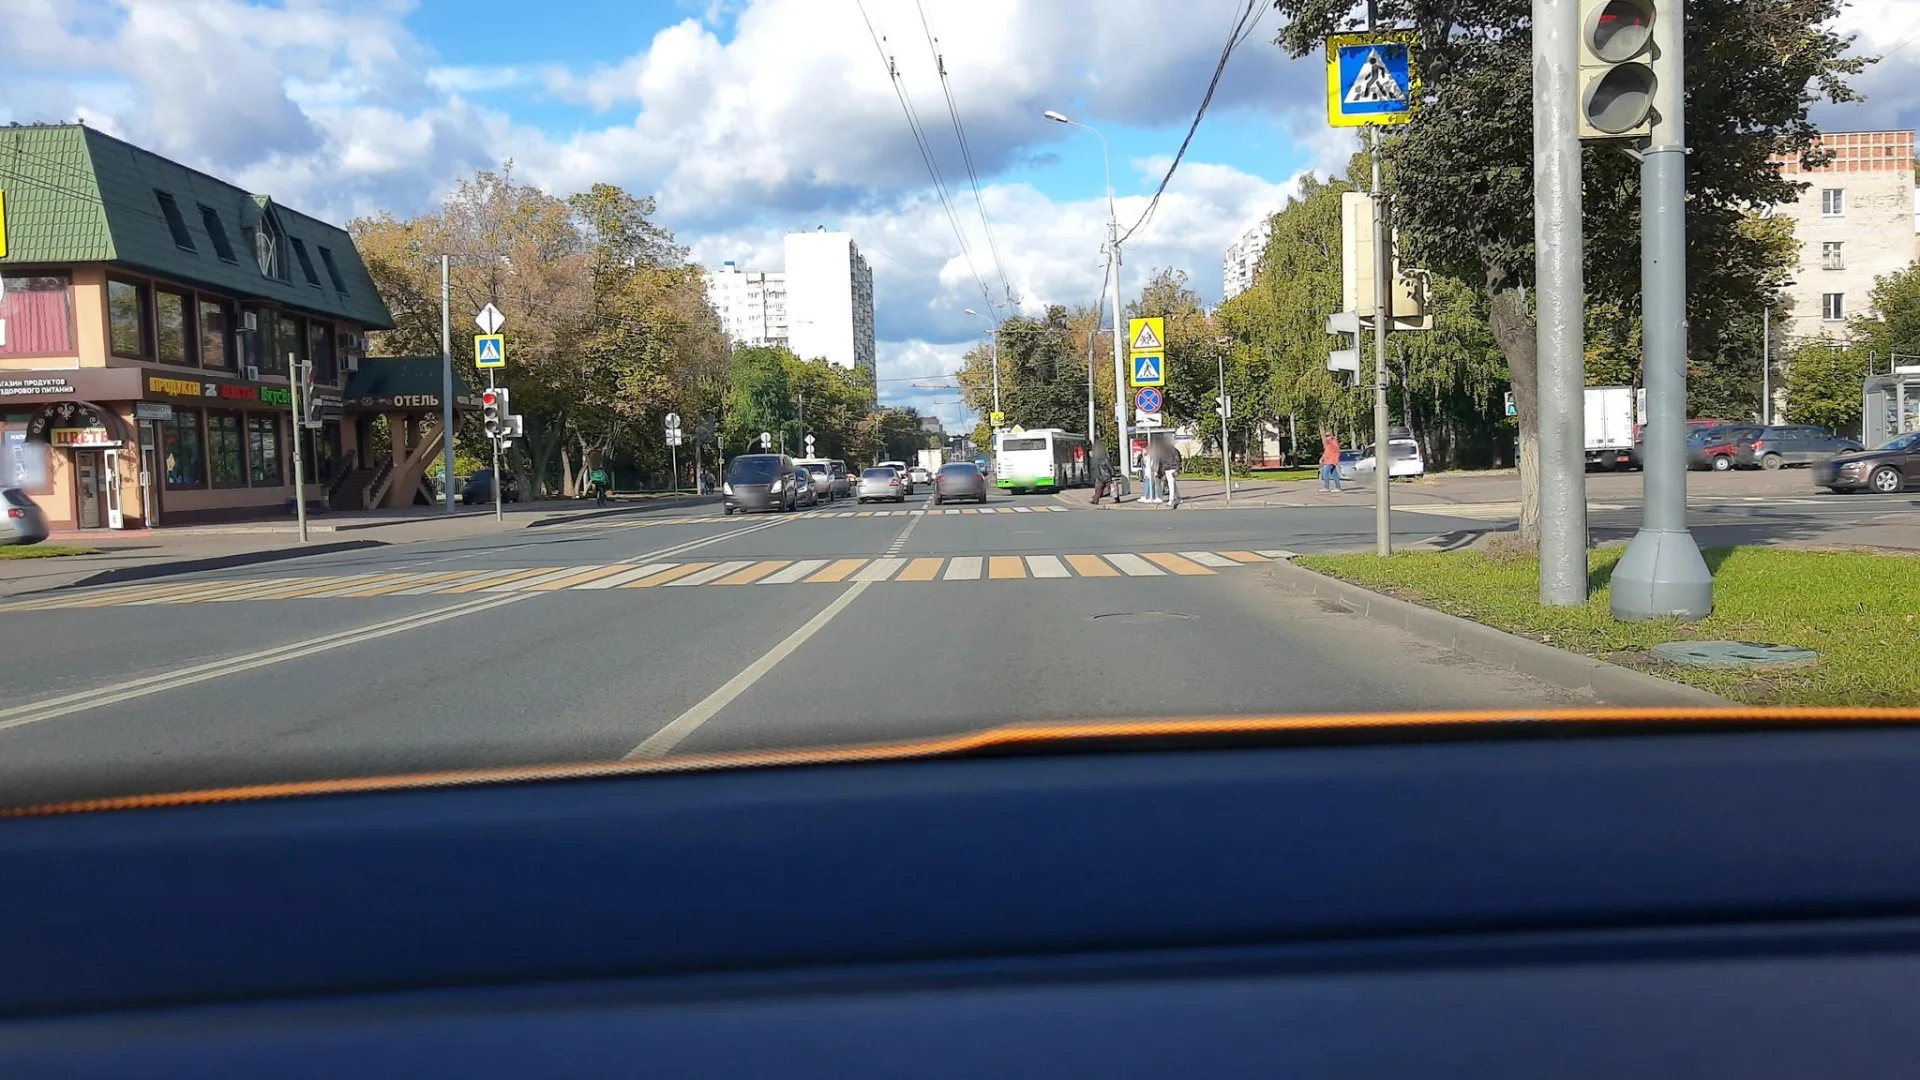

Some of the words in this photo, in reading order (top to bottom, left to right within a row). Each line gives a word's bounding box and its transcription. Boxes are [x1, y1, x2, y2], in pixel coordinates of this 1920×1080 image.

[42, 386, 74, 394] ПИТАНИЯ
[150, 377, 200, 396] ПРОДУКТЫ
[394, 395, 439, 406] ОТЕЛЬ
